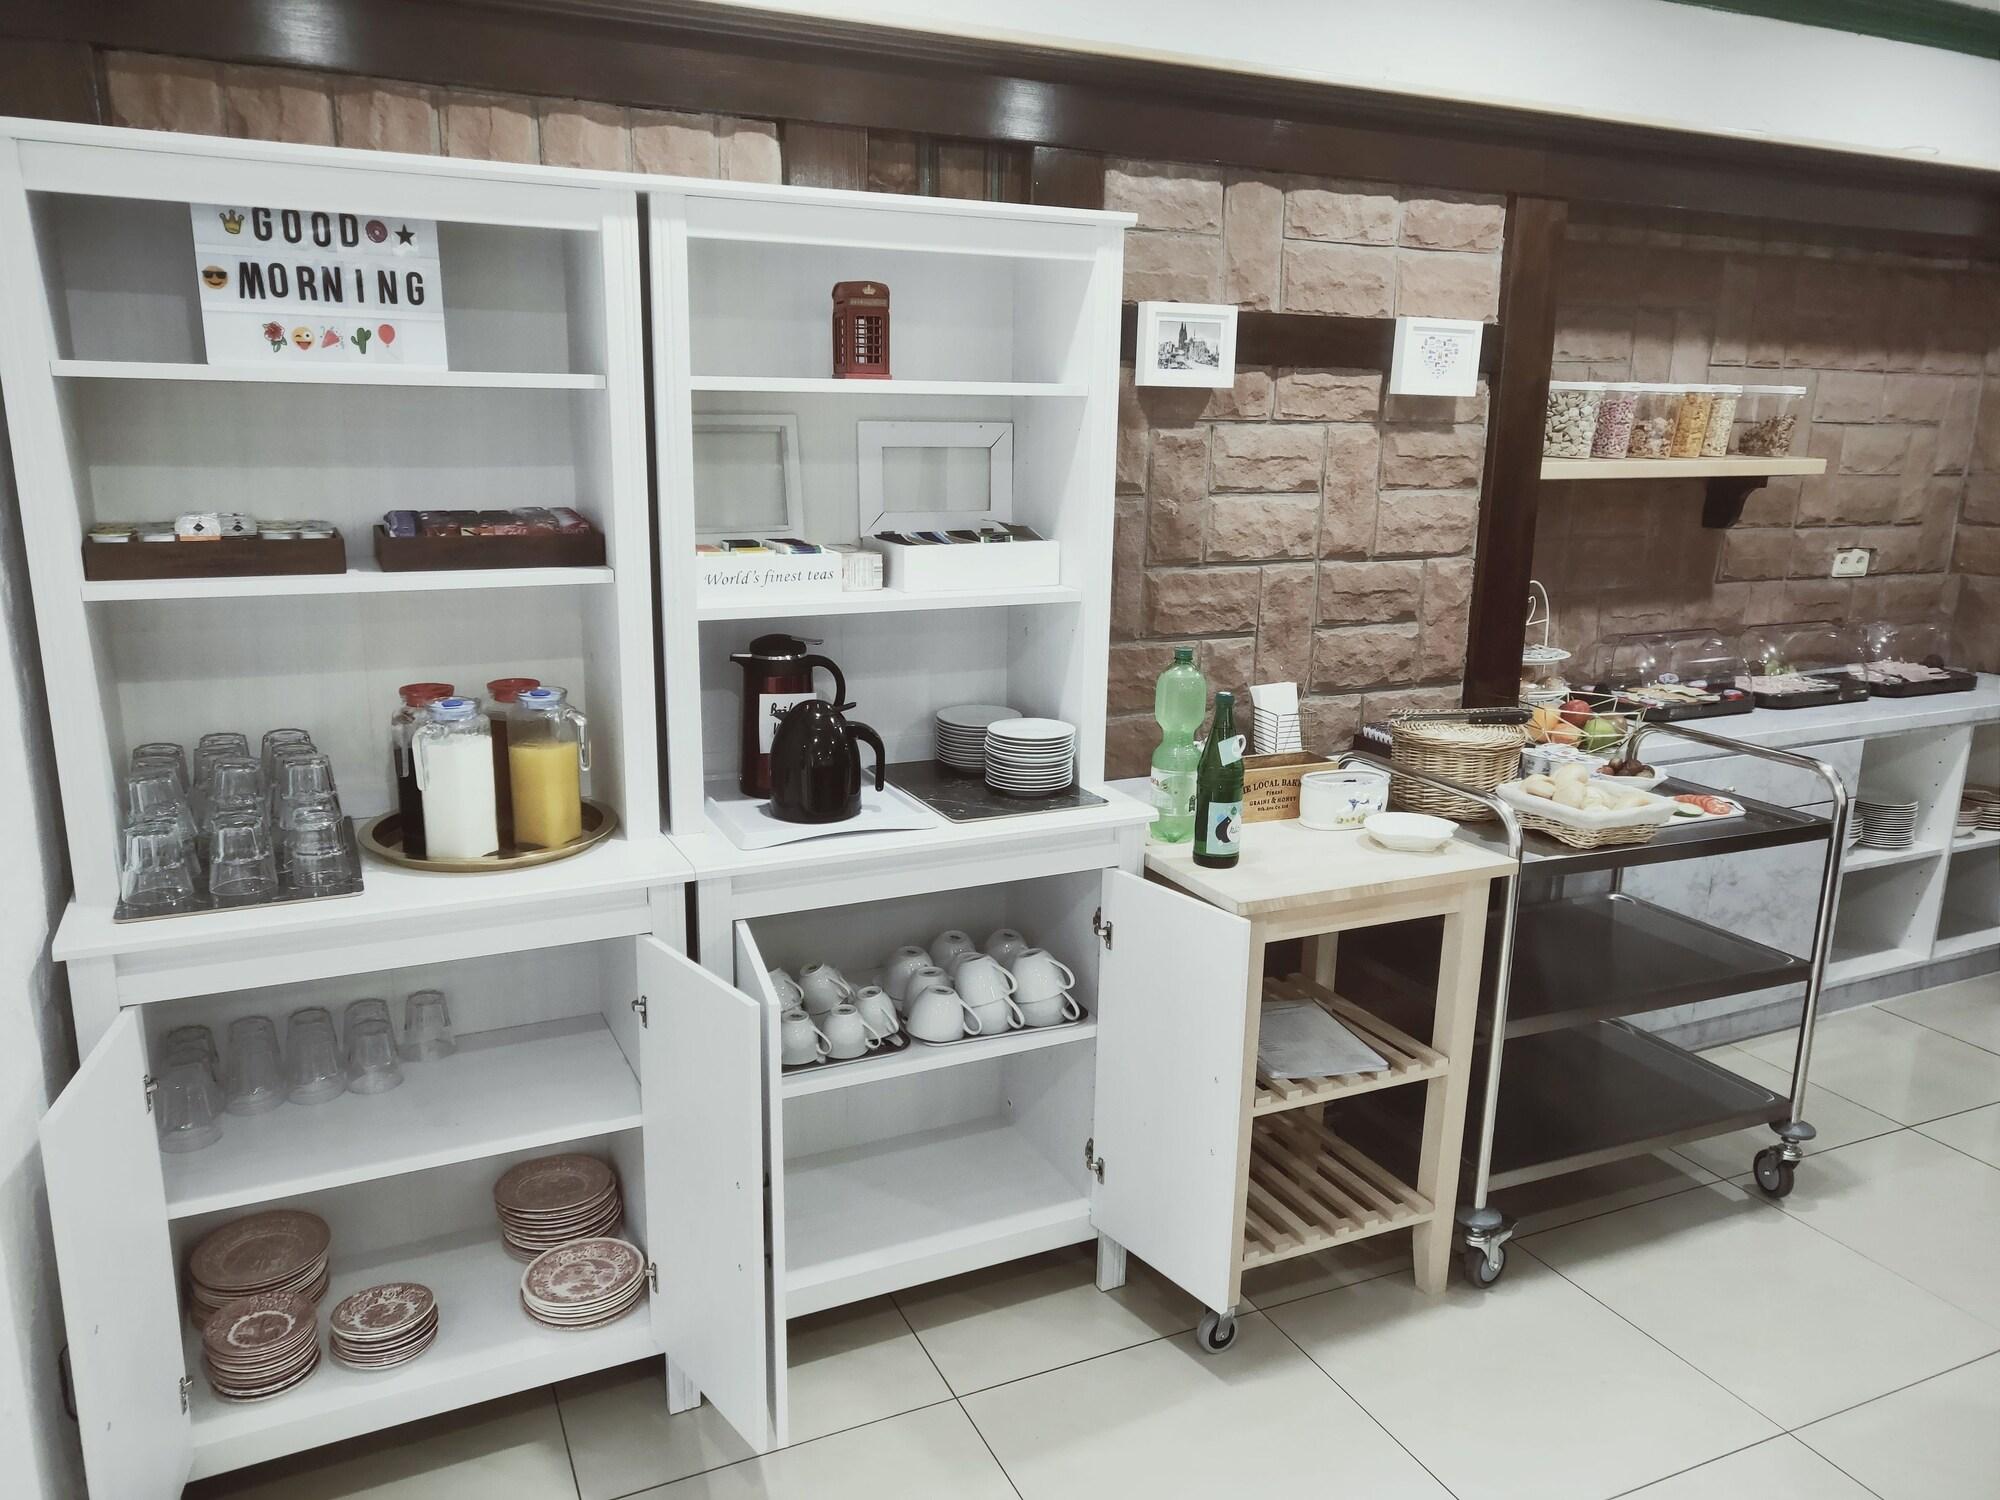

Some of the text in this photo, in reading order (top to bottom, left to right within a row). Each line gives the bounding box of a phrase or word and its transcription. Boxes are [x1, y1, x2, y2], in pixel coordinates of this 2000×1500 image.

[252, 207, 359, 248] GOOD
[239, 261, 425, 306] MORNING
[704, 569, 834, 588] World's finest teas
[1253, 779, 1279, 791] LOCAL
